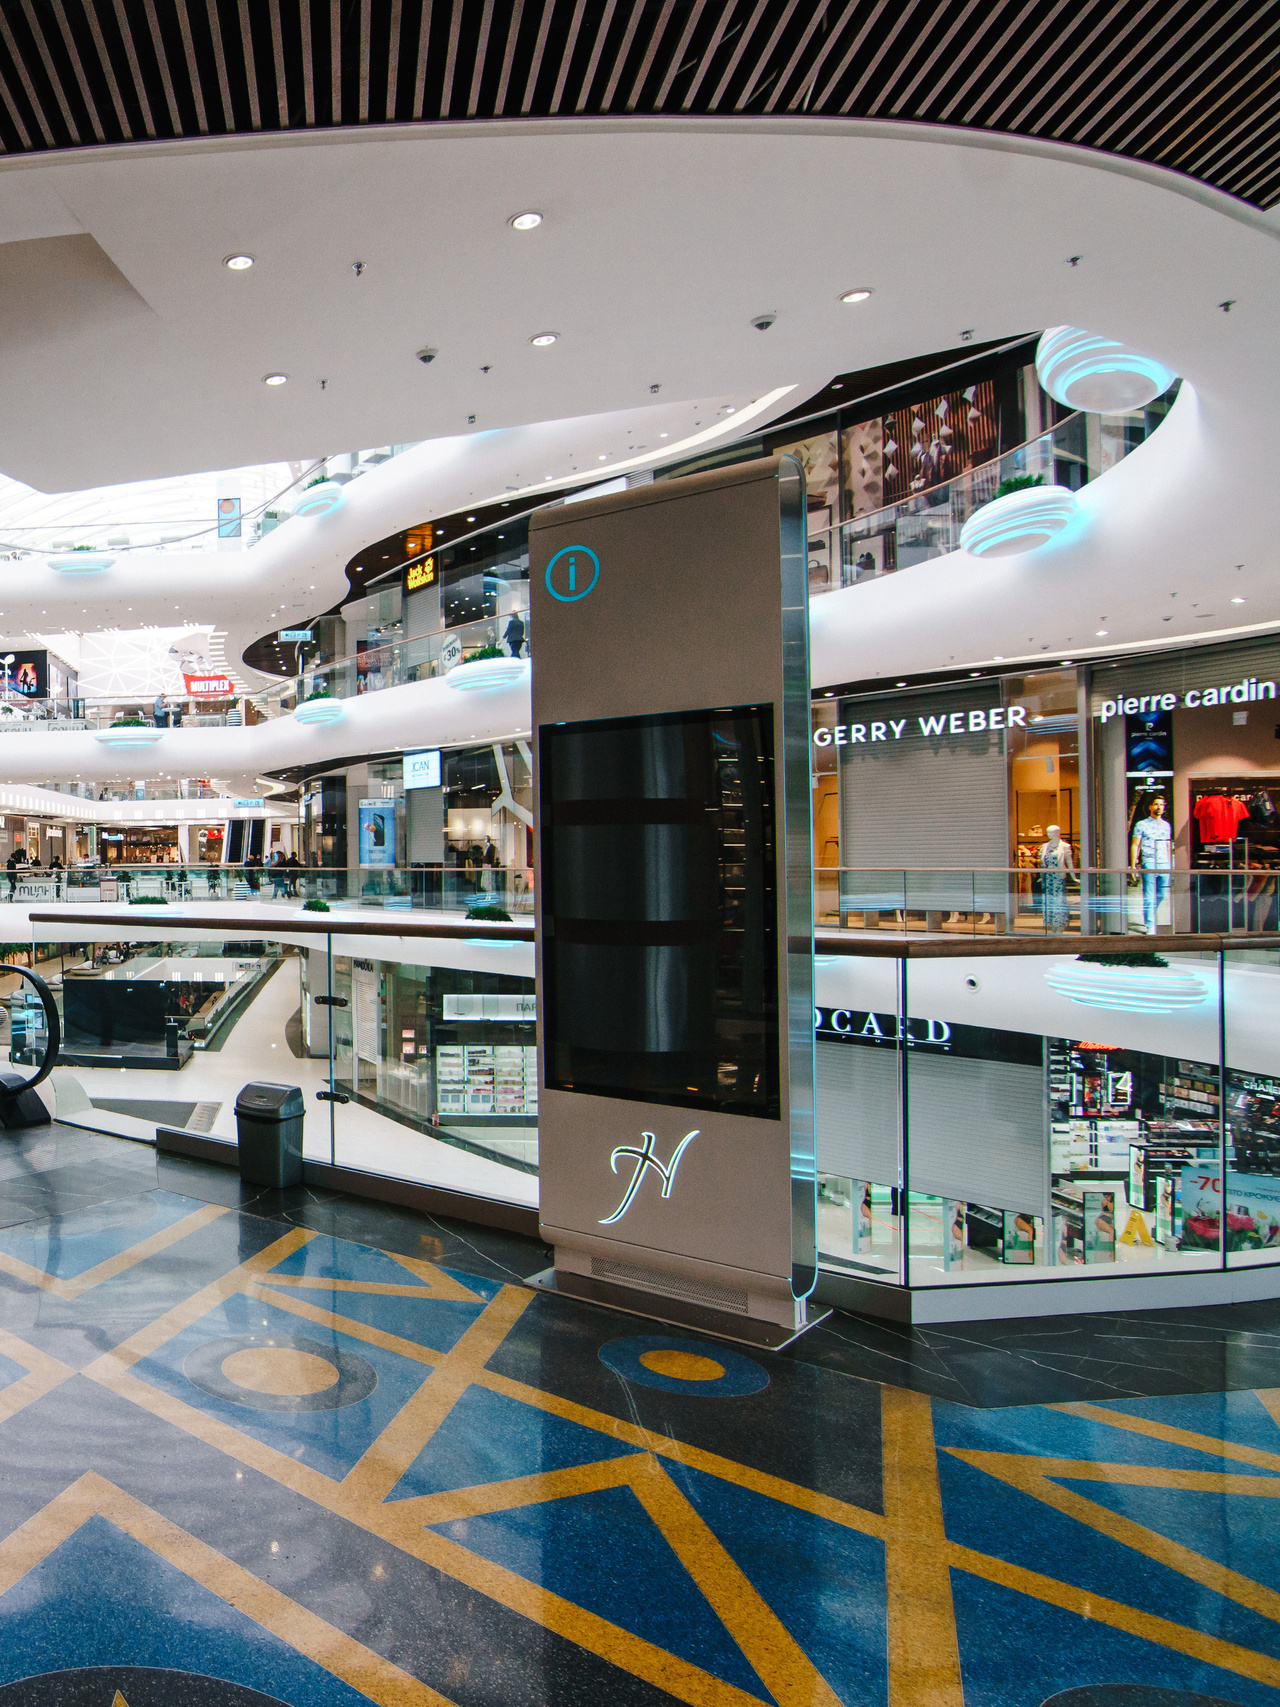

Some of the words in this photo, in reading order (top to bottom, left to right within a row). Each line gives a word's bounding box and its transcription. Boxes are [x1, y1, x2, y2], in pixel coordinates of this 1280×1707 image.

[408, 564, 423, 580] Jack
[191, 679, 230, 692] MULTIPLEX
[1100, 693, 1177, 723] pierre
[1184, 677, 1277, 708] cardin
[813, 719, 907, 747] GERRY
[918, 706, 1026, 737] WEBER
[1243, 1080, 1280, 1095] CHANE
